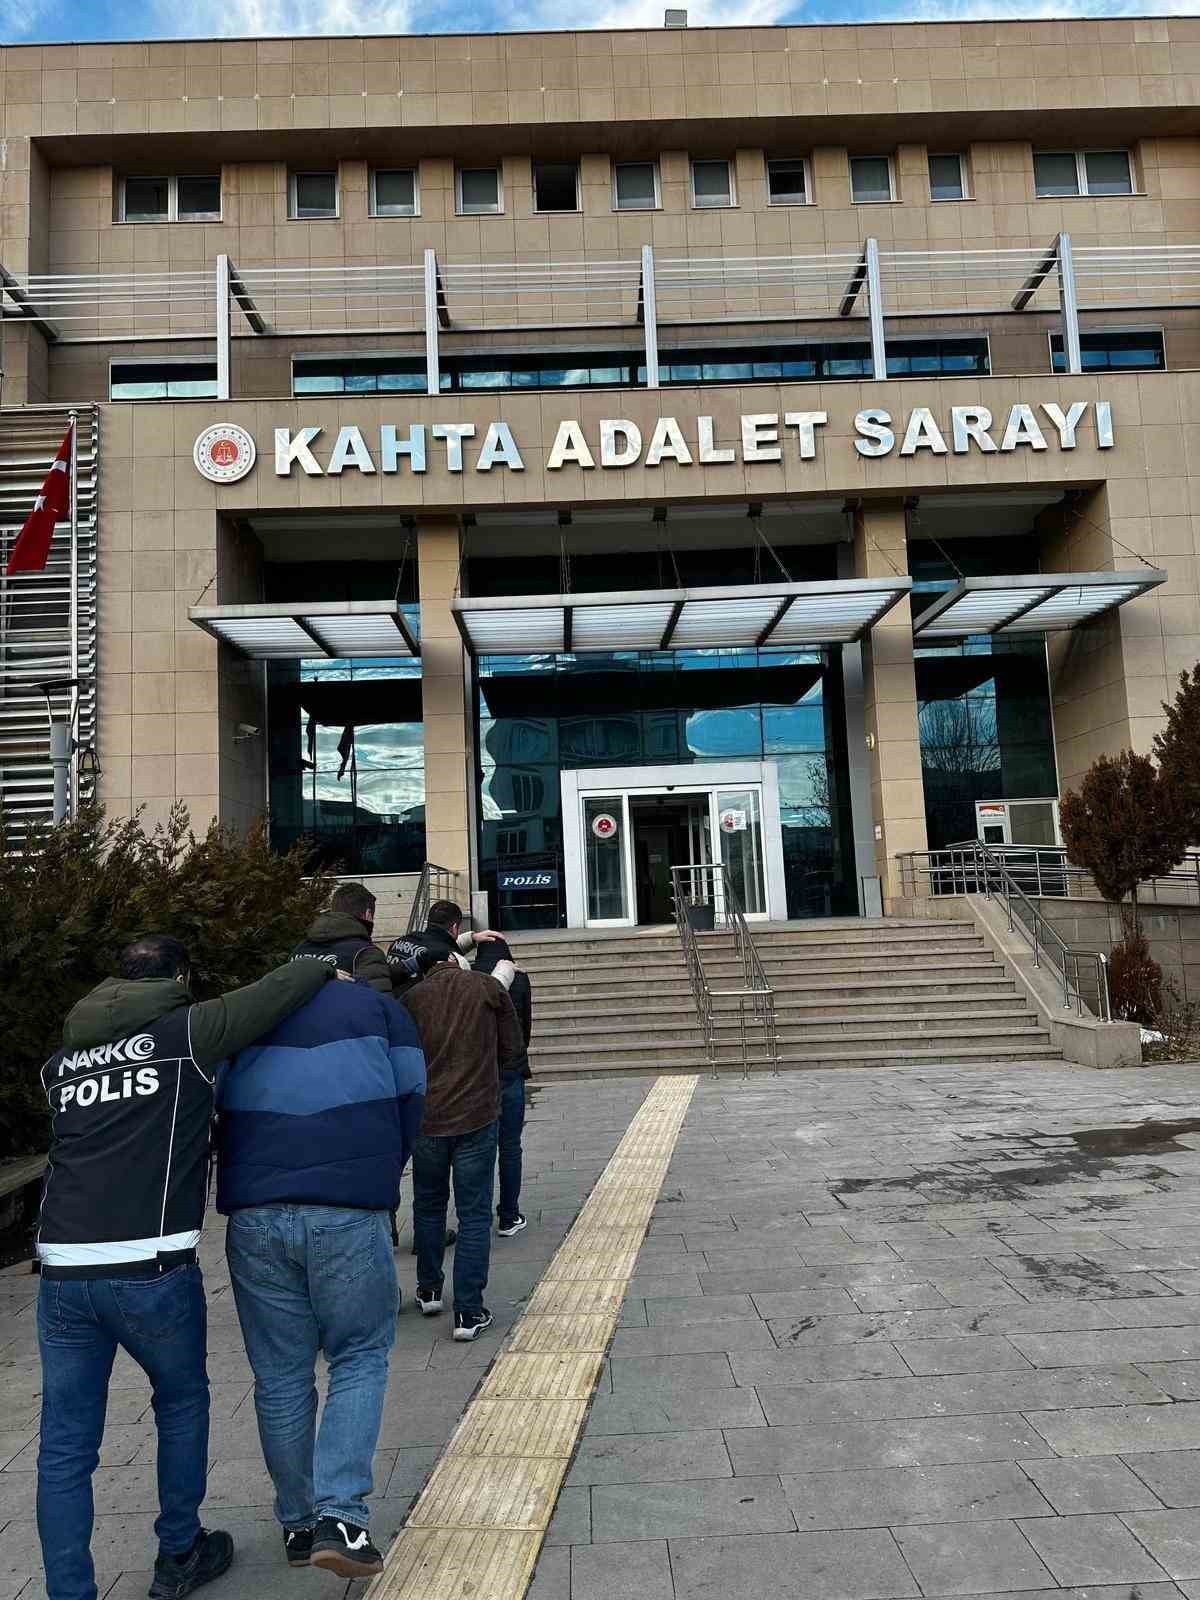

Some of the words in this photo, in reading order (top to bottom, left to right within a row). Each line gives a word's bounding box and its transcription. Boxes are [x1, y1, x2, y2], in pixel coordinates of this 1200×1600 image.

[274, 421, 525, 477] KAHTA
[546, 410, 827, 471] ADALET
[853, 401, 1115, 458] SARAYI
